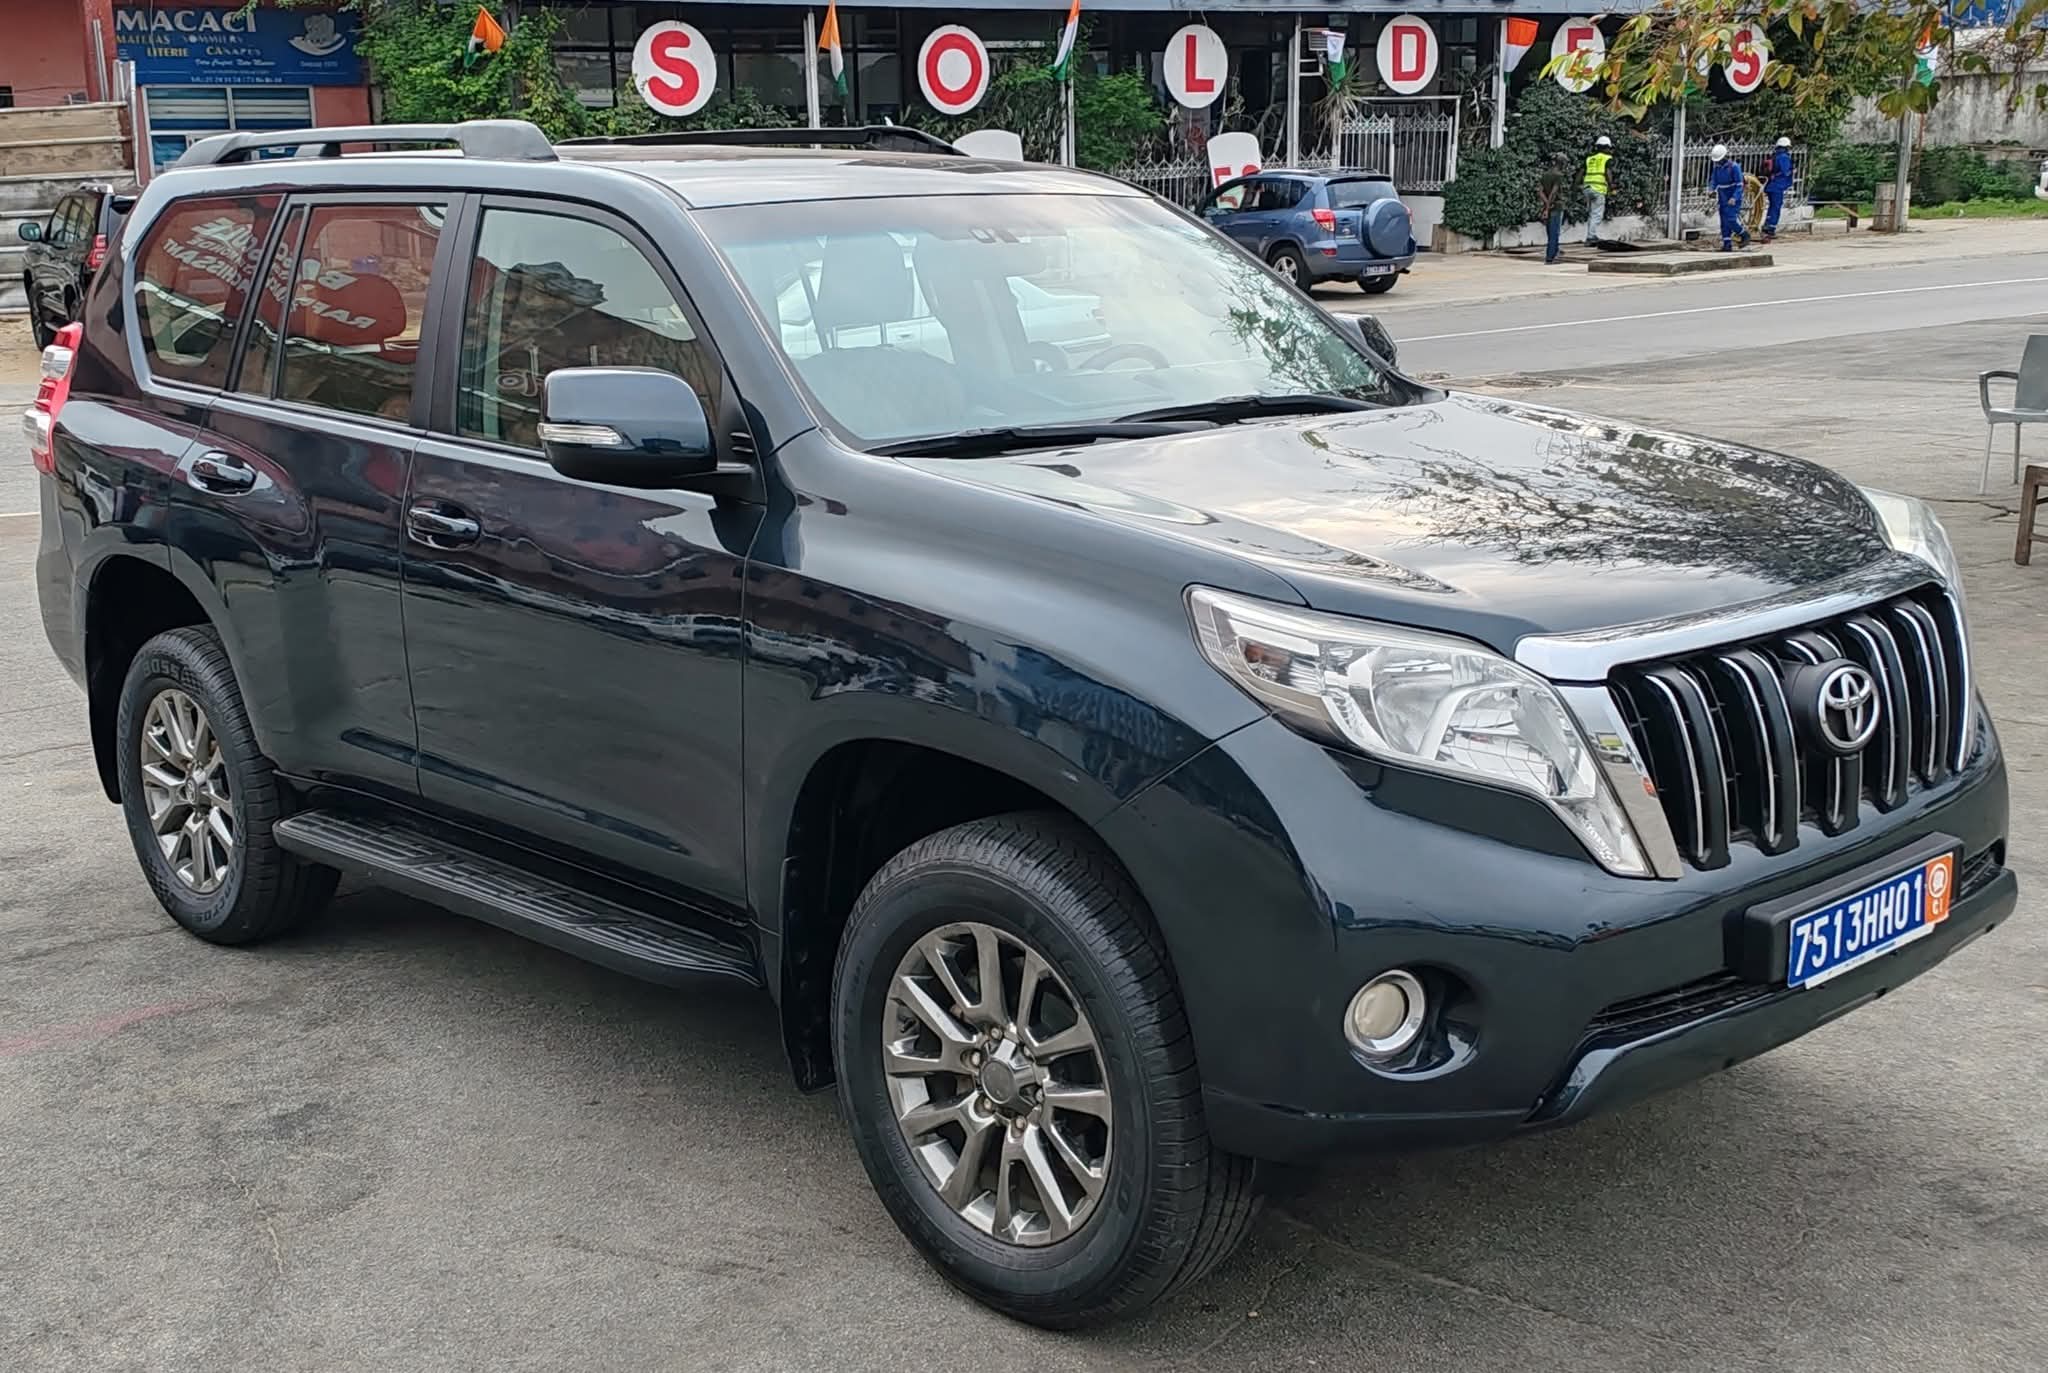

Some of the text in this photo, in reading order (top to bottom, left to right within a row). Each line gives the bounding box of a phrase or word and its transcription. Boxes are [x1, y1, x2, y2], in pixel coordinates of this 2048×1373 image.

[116, 10, 257, 33] MACACI
[147, 47, 189, 57] LITERIE
[1795, 873, 1923, 977] 7513HH01
